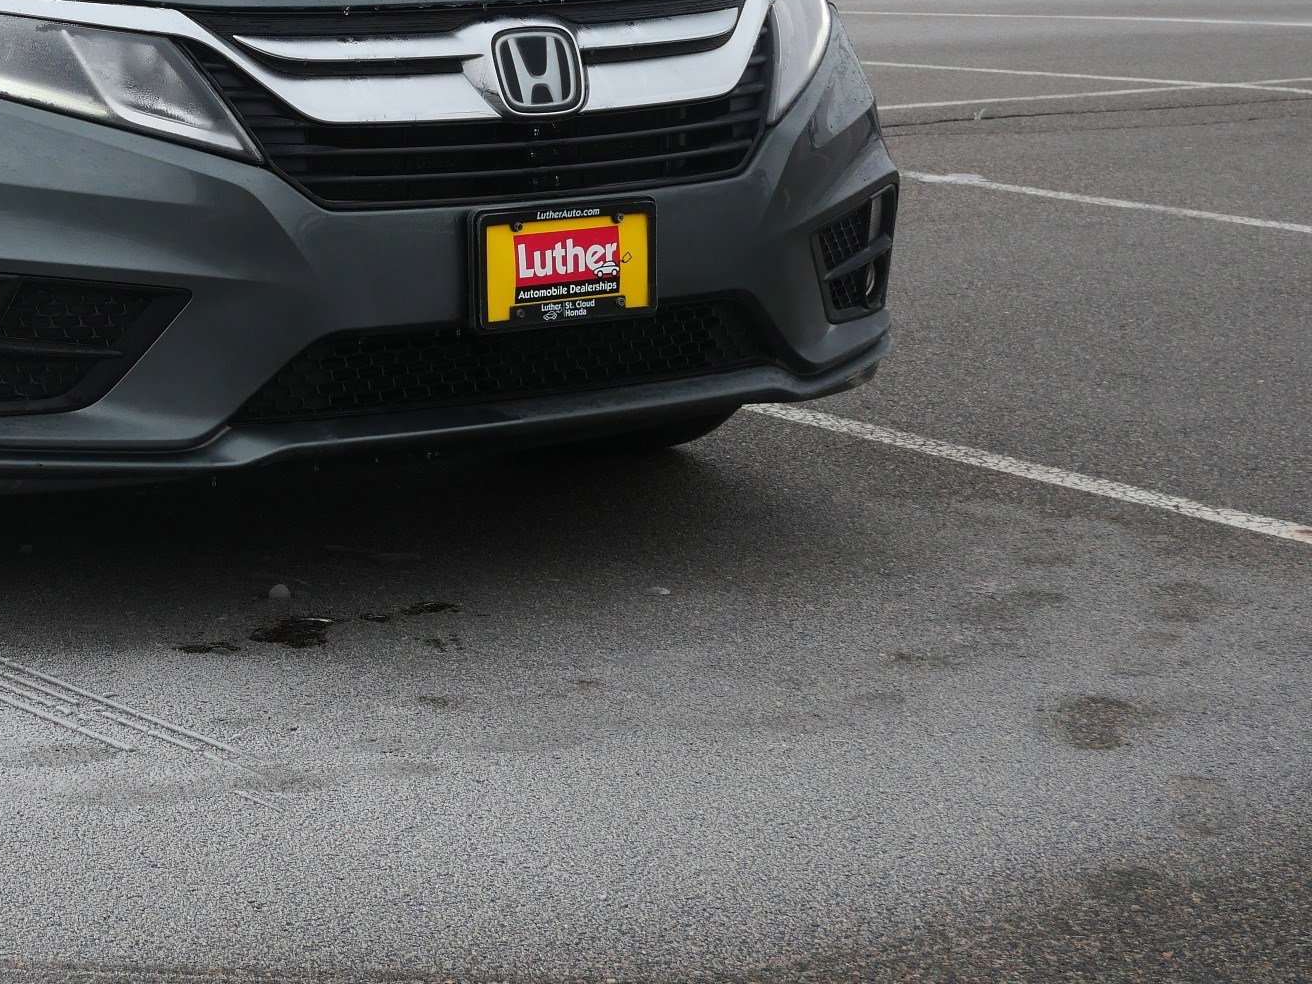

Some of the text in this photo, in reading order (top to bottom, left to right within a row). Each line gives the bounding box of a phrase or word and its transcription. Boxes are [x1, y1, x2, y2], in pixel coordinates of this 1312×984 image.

[537, 208, 599, 219] LutherAuto.com
[518, 238, 617, 278] Luther
[518, 280, 617, 299] Automobile Dealerships
[576, 299, 595, 309] Cloud
[565, 308, 587, 317] Honda
